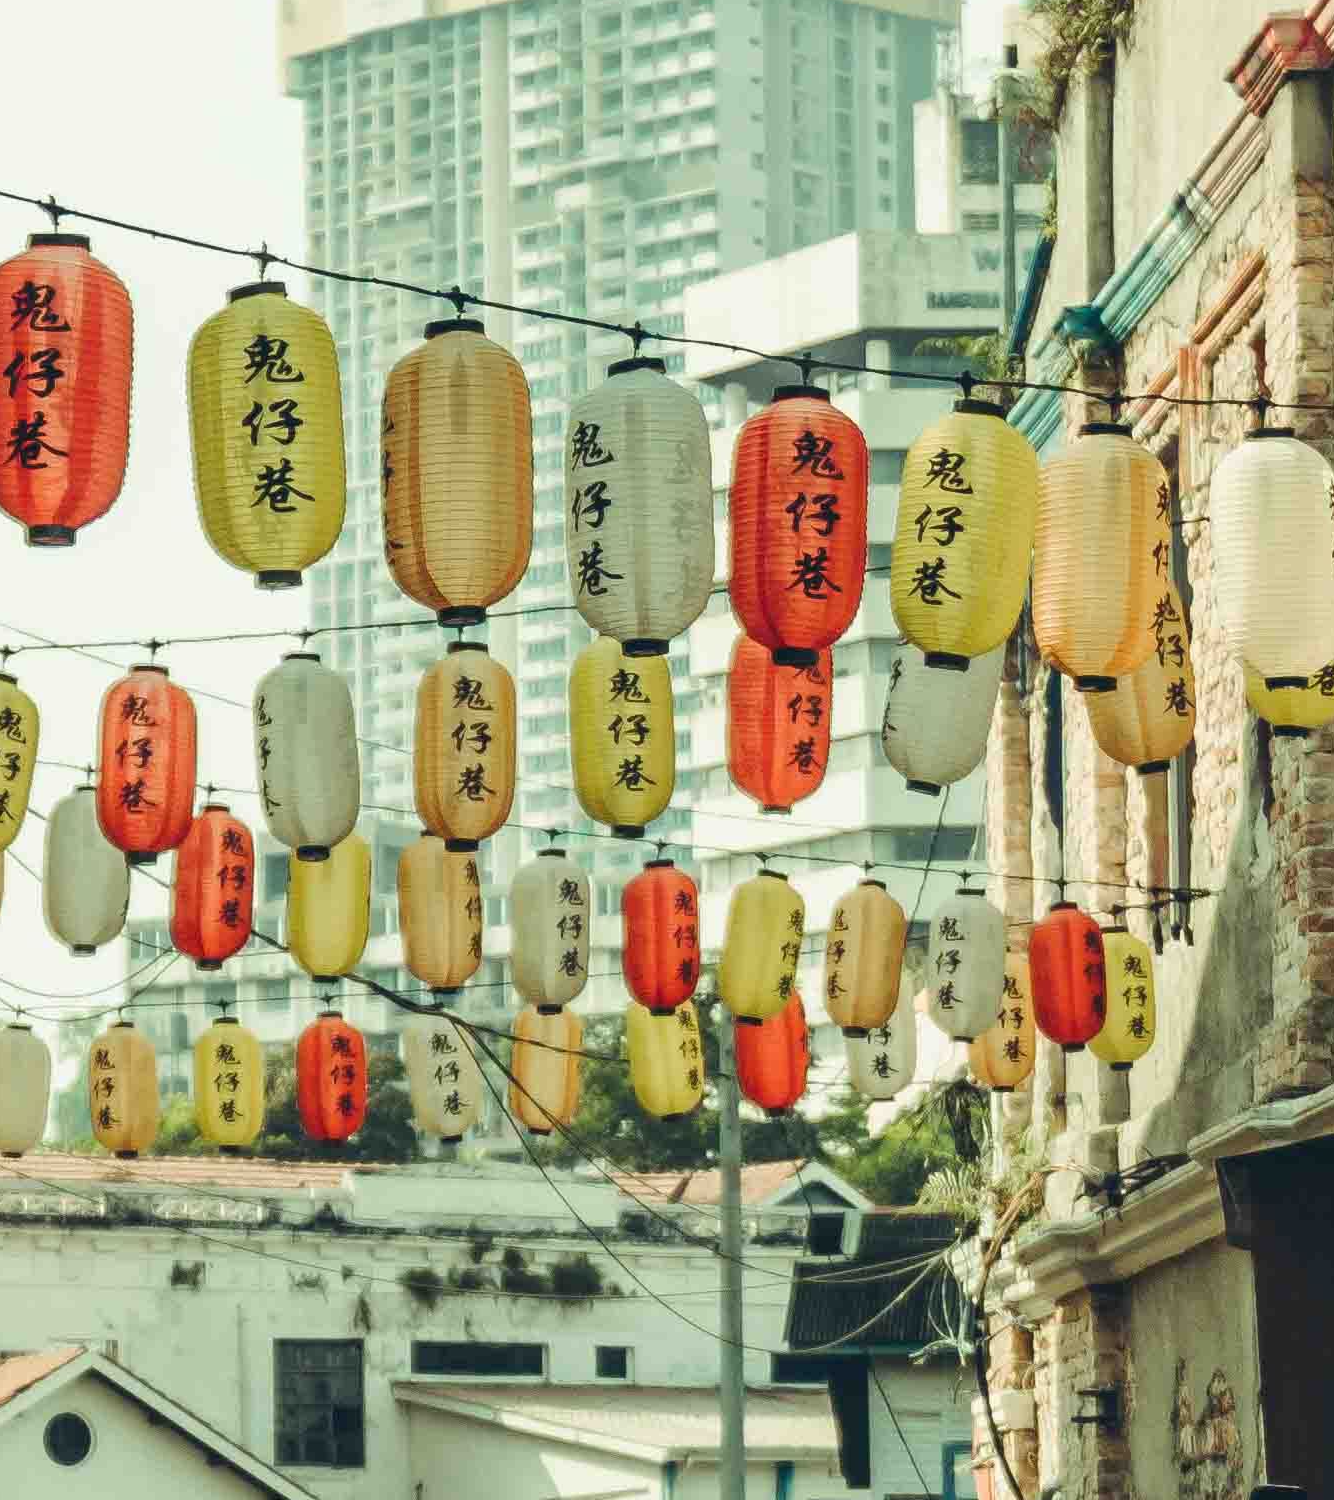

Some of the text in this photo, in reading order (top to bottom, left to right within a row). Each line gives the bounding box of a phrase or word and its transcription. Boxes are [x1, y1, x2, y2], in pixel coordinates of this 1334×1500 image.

[3, 281, 71, 470] 鬼仔巷
[241, 333, 315, 513] 鬼仔巷
[570, 420, 624, 596] 鬼仔巷
[785, 429, 845, 601] 鬼仔巷
[907, 447, 973, 605] 鬼仔巷
[113, 692, 157, 814] 鬼仔巷
[450, 674, 496, 802] 鬼仔巷
[607, 667, 657, 792] 鬼仔巷
[216, 830, 247, 928] 鬼仔巷
[556, 876, 585, 978] 鬼仔巷
[935, 916, 965, 1010] 鬼仔巷
[1123, 953, 1152, 1039] 鬼仔巷
[996, 974, 1028, 1063] 鬼仔巷
[93, 1048, 121, 1129] 鬼仔巷
[214, 1042, 243, 1123] 鬼仔巷
[329, 1033, 356, 1118] 鬼仔巷
[431, 1032, 467, 1118] 鬼仔巷
